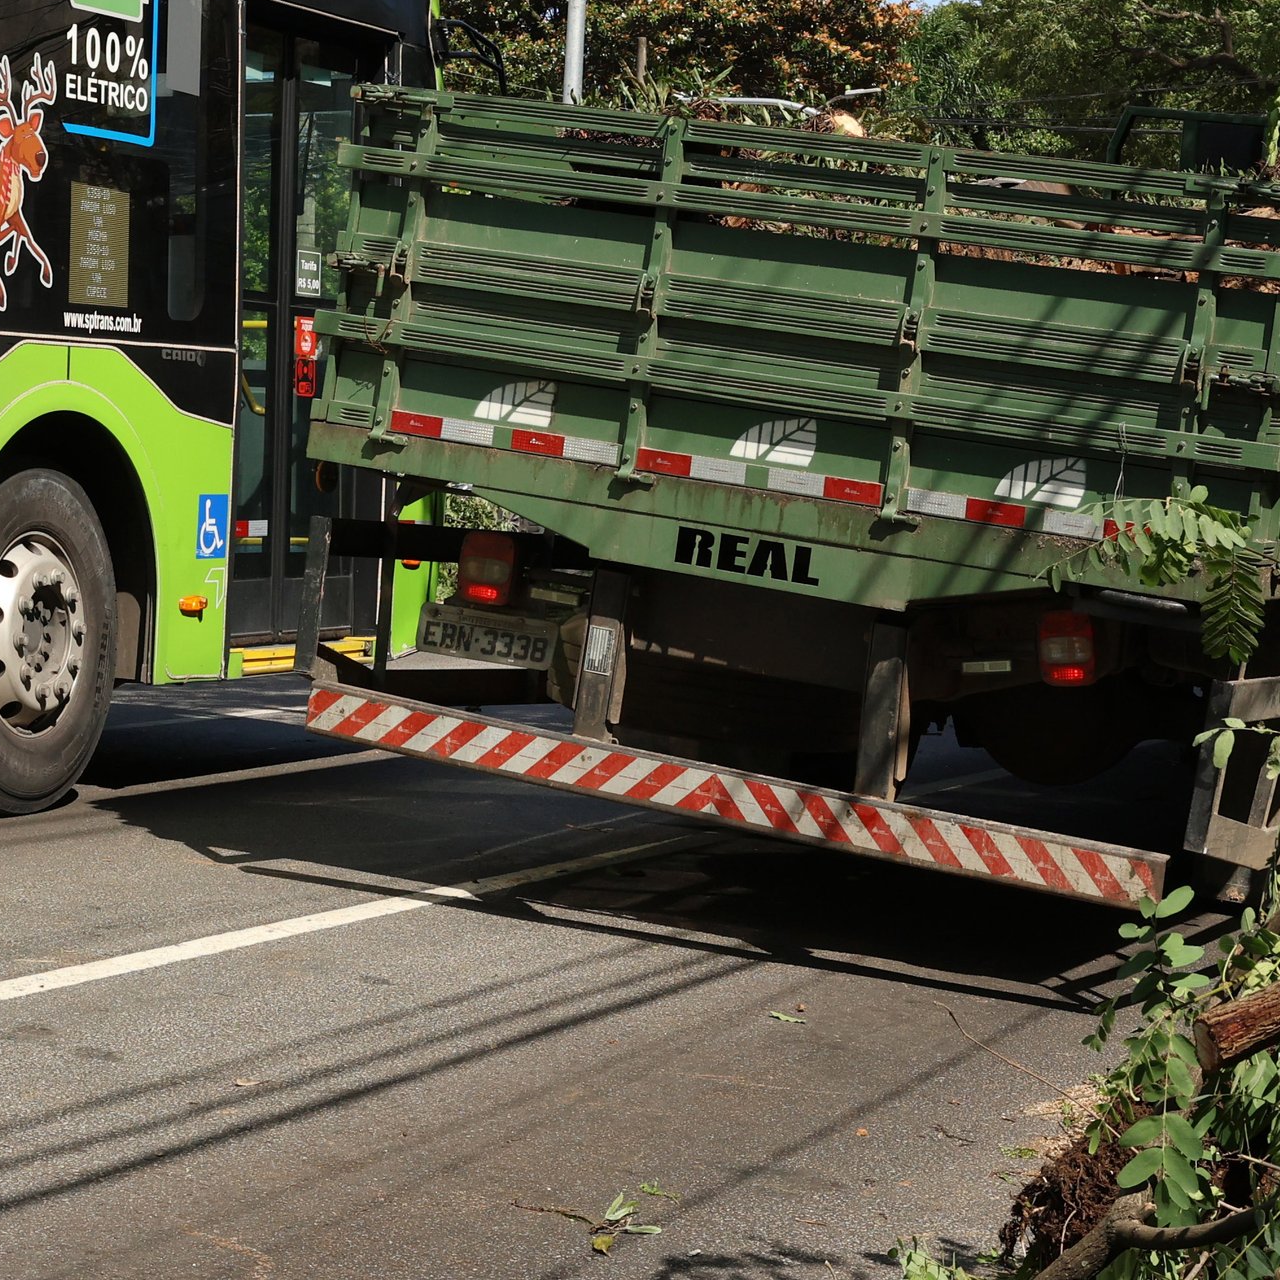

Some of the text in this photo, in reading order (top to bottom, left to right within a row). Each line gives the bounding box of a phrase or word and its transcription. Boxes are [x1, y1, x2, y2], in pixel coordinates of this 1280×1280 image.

[66, 23, 149, 80] 100%
[65, 71, 148, 112] ELÉTRICO
[300, 259, 318, 271] Tarifa
[307, 278, 320, 291] 5,00
[63, 310, 142, 335] www.sptrans.com.br
[674, 526, 819, 587] REAL
